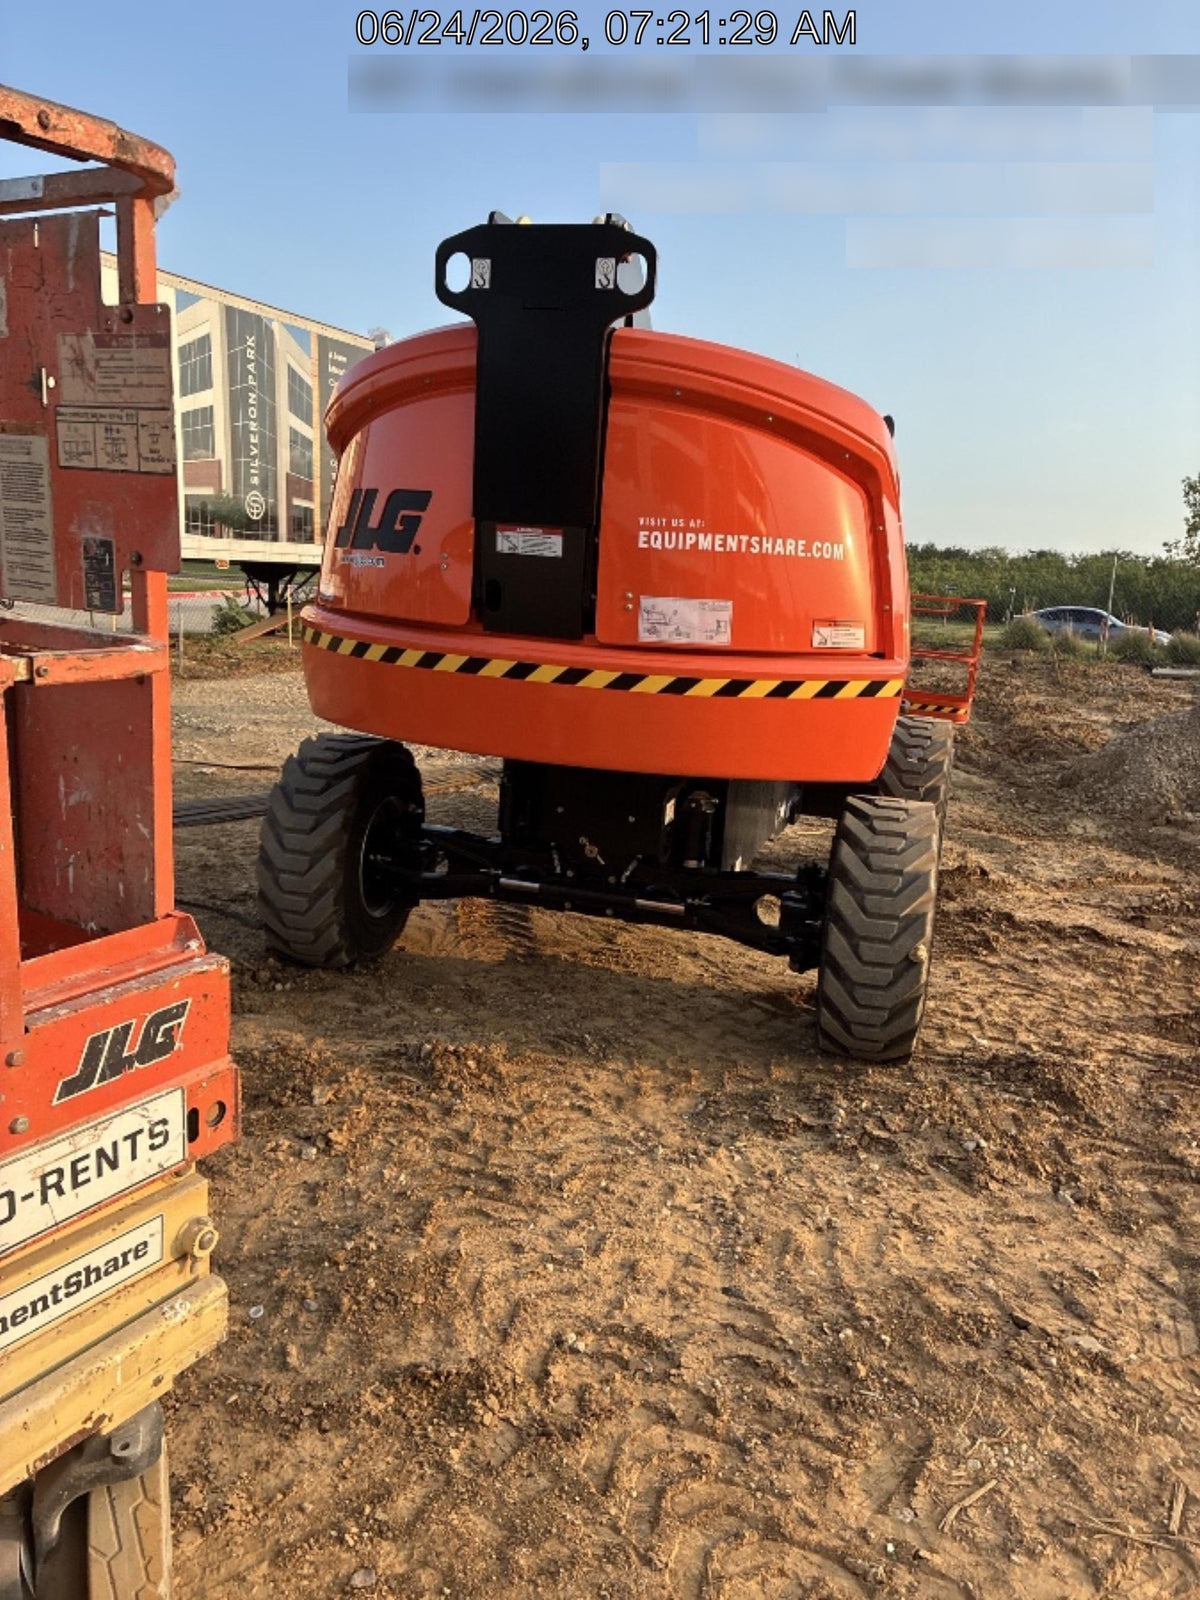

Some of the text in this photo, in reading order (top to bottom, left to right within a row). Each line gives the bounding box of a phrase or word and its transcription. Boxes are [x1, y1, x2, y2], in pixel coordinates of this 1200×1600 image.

[246, 335, 260, 486] SILVERON PARK
[334, 488, 432, 553] JLG
[638, 517, 667, 527] VISIT
[671, 518, 685, 527] US
[638, 531, 844, 560] EQUIPMENTSHARE.COM
[52, 998, 191, 1106] JLG
